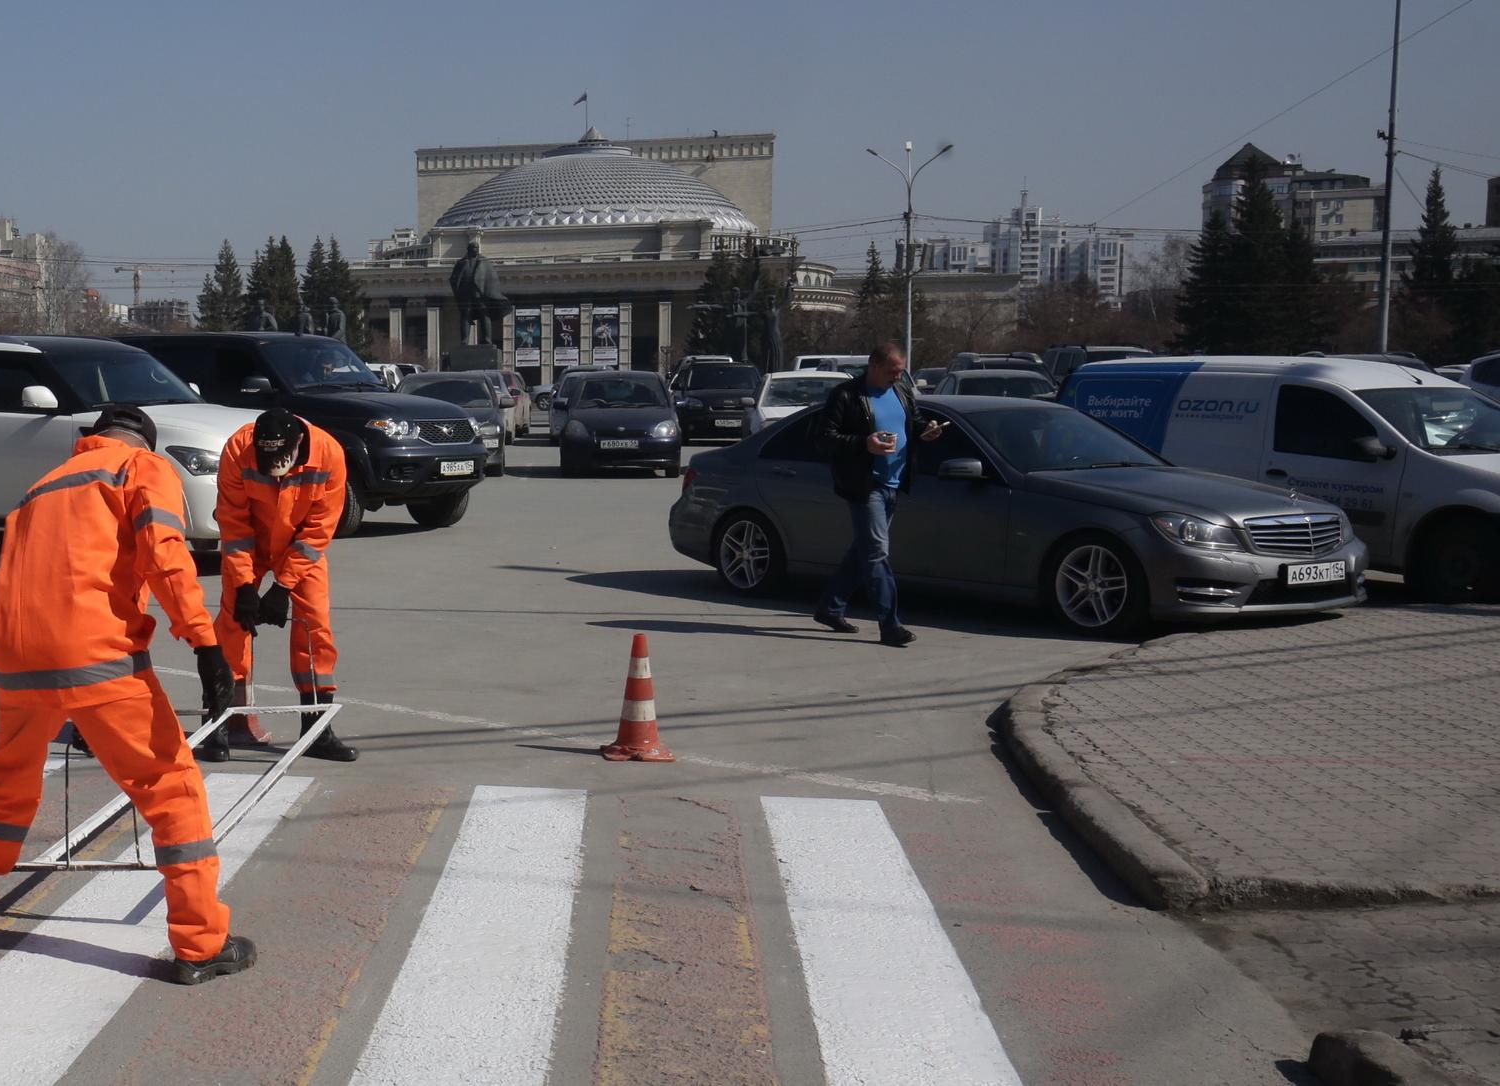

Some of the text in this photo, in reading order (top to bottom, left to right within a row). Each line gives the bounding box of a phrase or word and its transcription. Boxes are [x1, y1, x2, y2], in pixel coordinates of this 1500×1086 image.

[1087, 395, 1152, 407] Выбирайте
[1178, 399, 1261, 414] ozon.ru
[1111, 408, 1145, 418] жить!
[1287, 476, 1384, 494] Станьте курьером
[1331, 562, 1344, 574] 154
